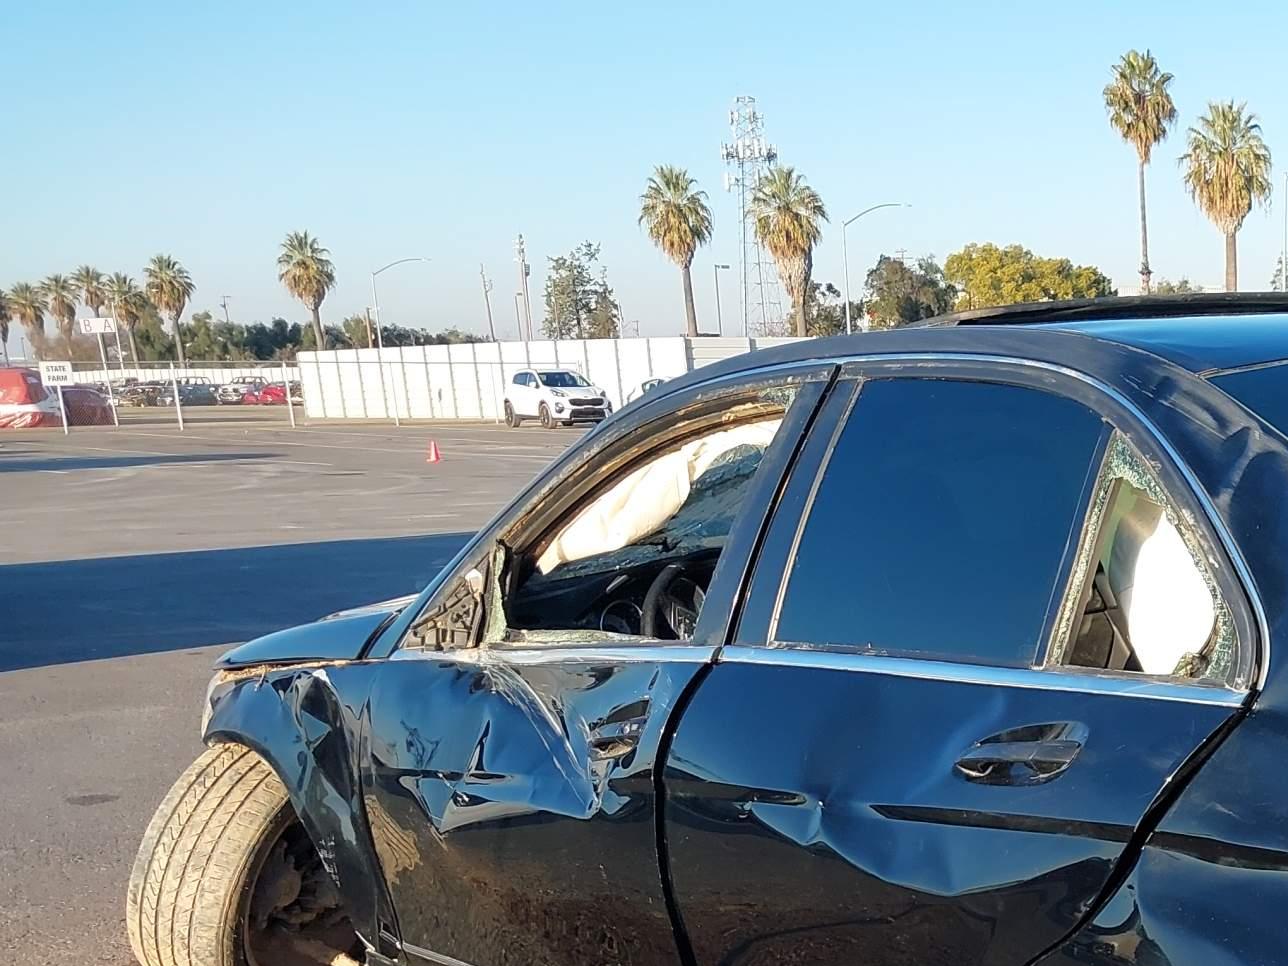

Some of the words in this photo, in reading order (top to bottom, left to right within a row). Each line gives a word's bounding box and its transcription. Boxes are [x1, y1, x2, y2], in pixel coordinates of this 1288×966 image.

[83, 319, 92, 333] B
[103, 319, 114, 332] A
[46, 365, 67, 373] STATE
